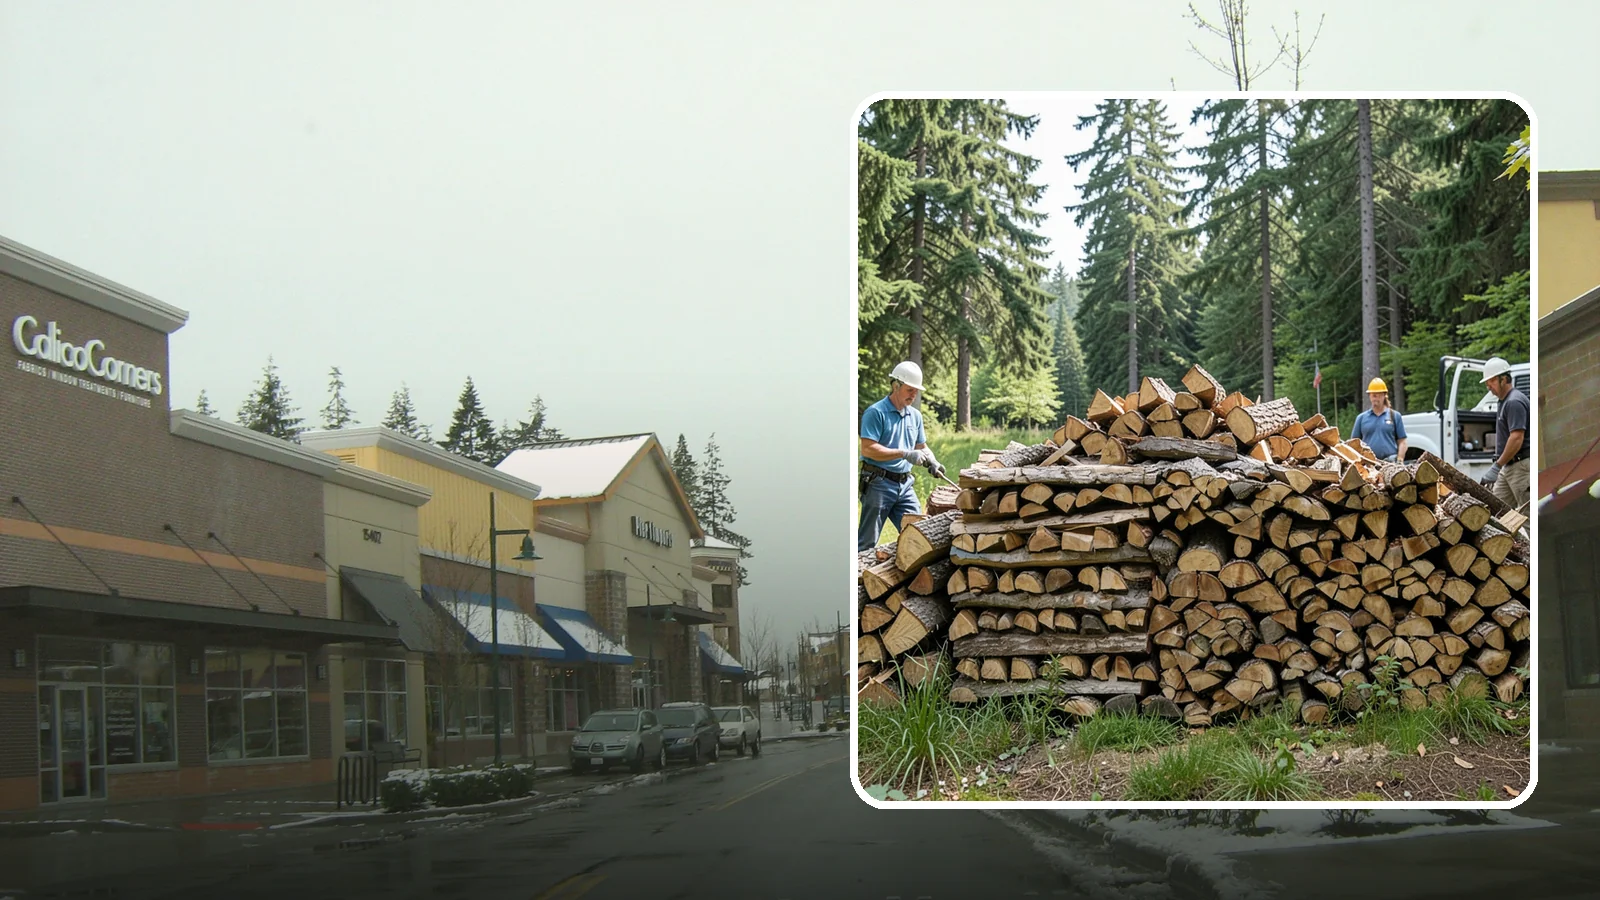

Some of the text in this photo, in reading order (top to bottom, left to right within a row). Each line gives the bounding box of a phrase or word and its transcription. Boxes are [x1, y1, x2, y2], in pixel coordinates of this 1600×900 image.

[16, 360, 152, 409] FABRICS WINDOW TREATMENTS FURNITURE
